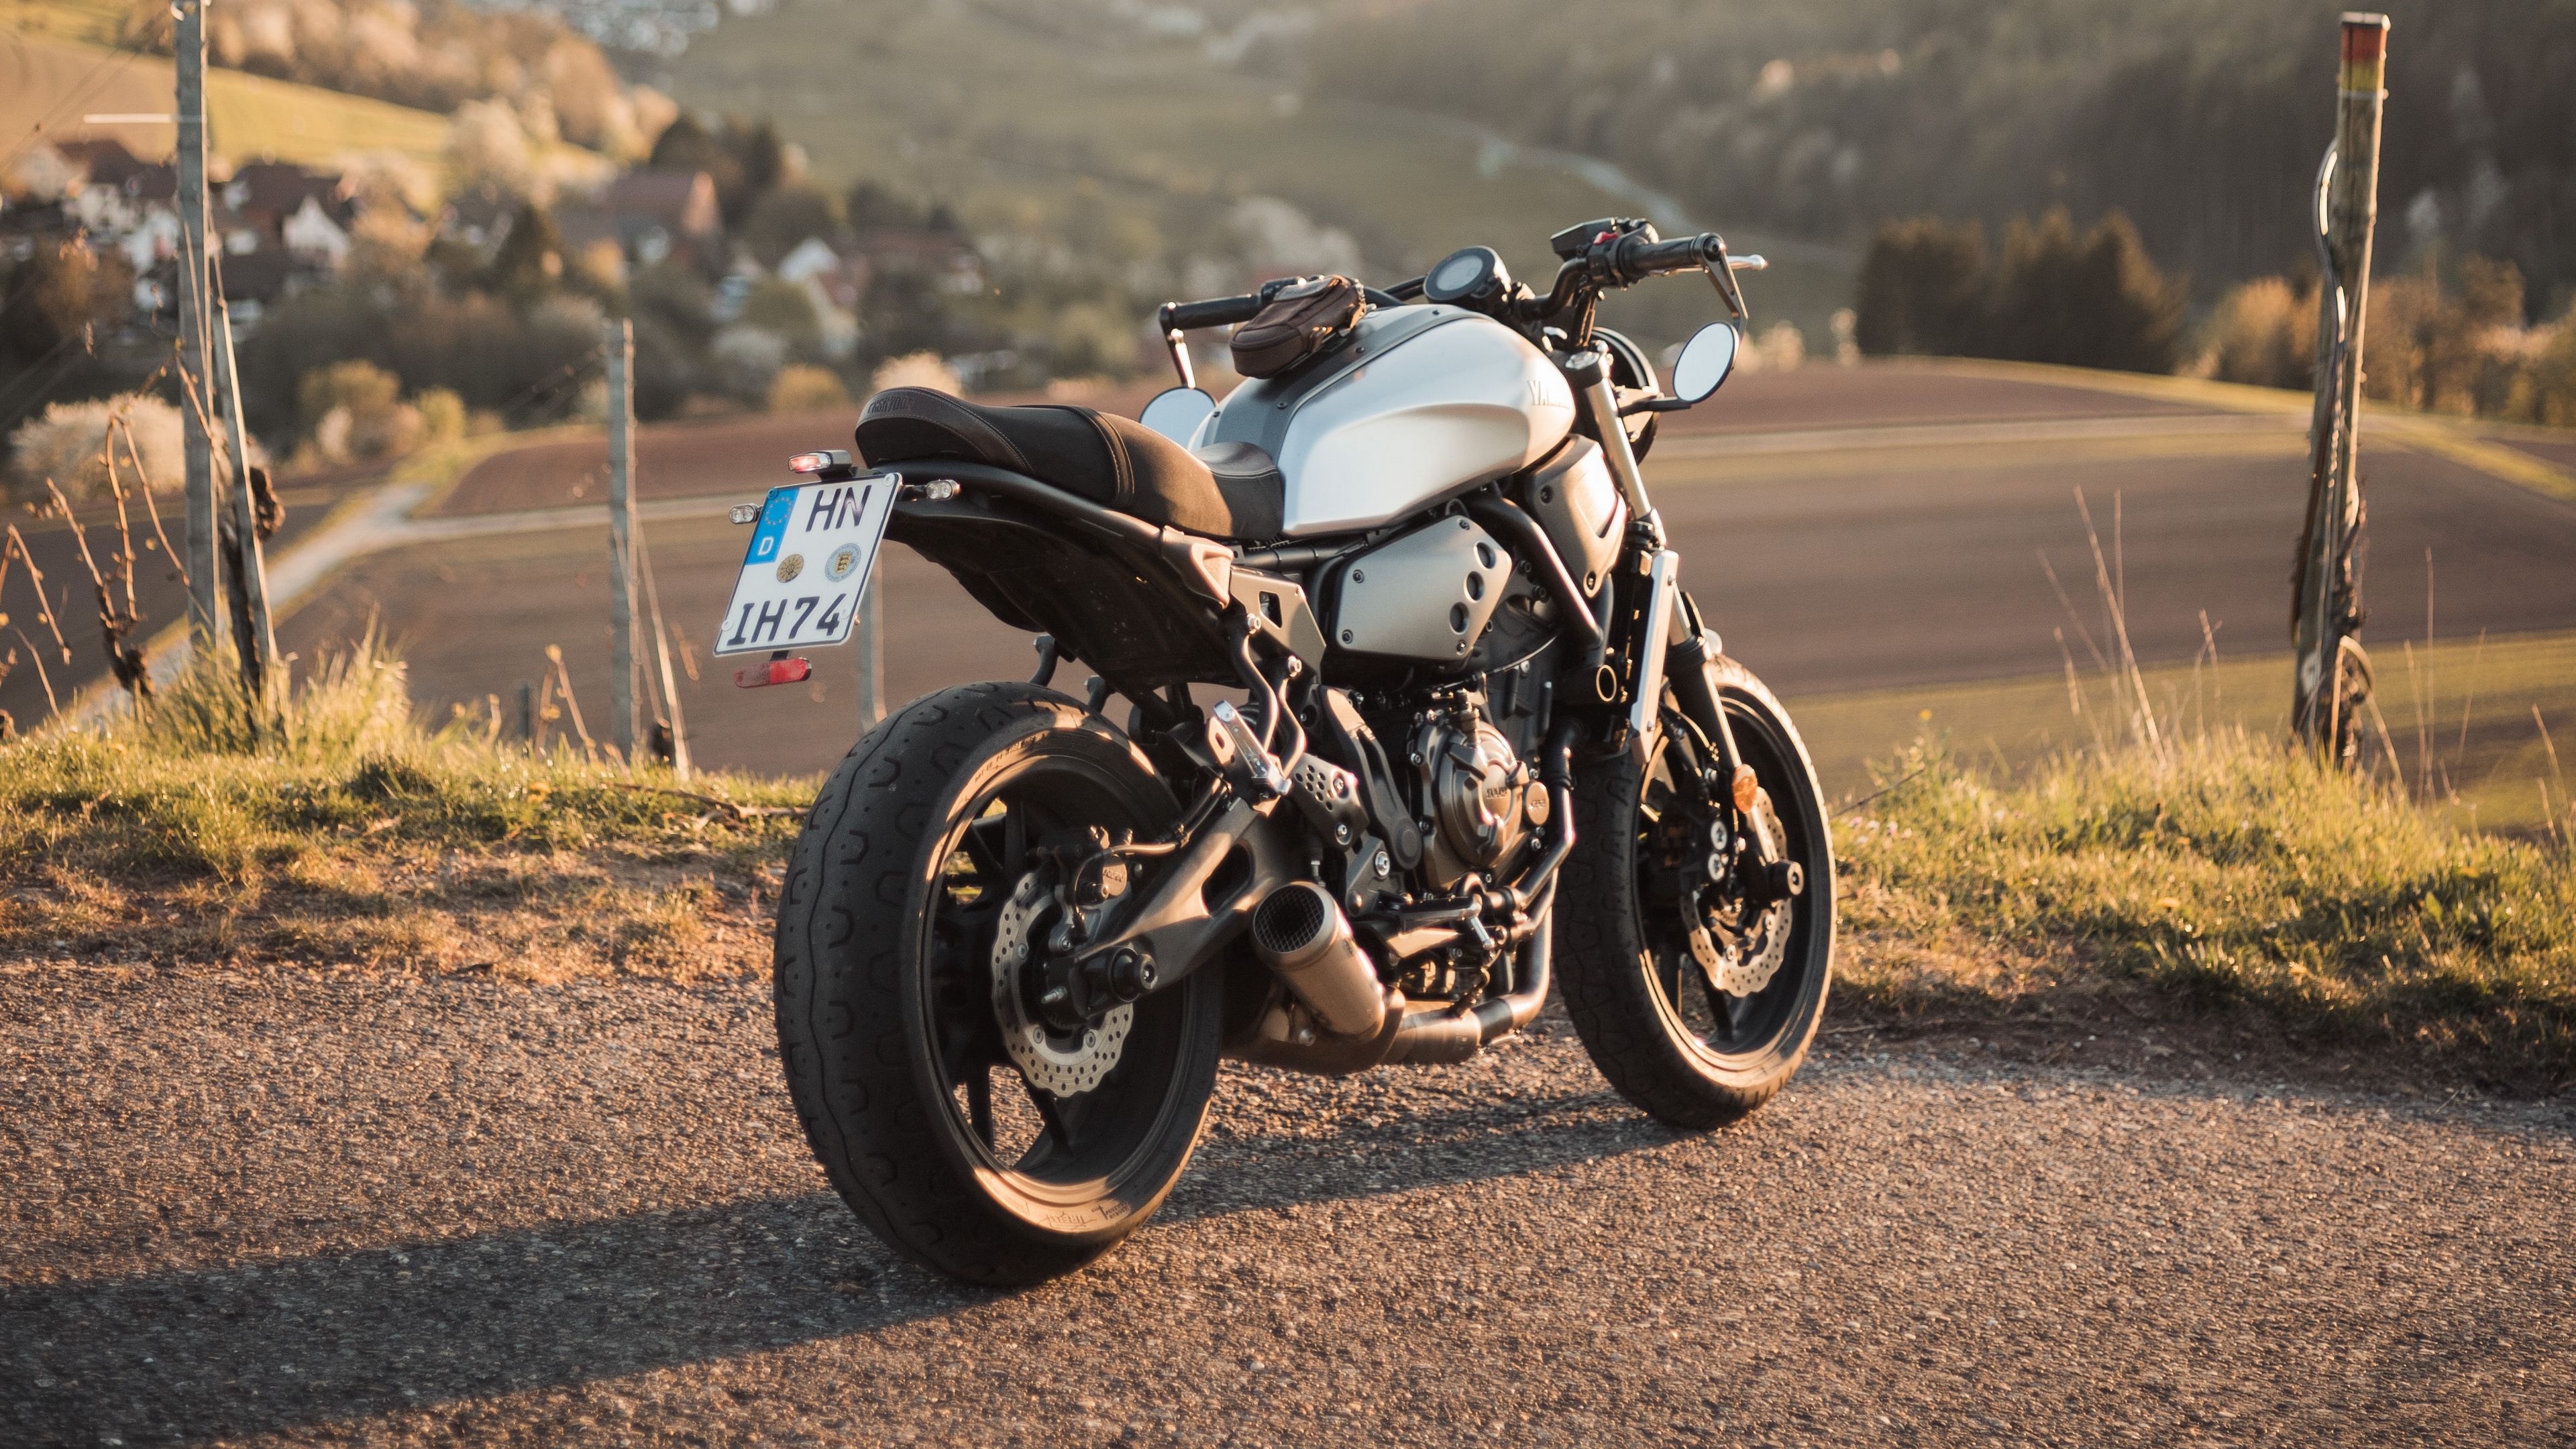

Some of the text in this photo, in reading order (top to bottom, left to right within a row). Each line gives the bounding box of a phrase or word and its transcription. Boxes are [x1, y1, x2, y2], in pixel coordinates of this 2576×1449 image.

[806, 485, 871, 532] HN
[757, 537, 773, 556] D
[727, 594, 847, 646] IH74
